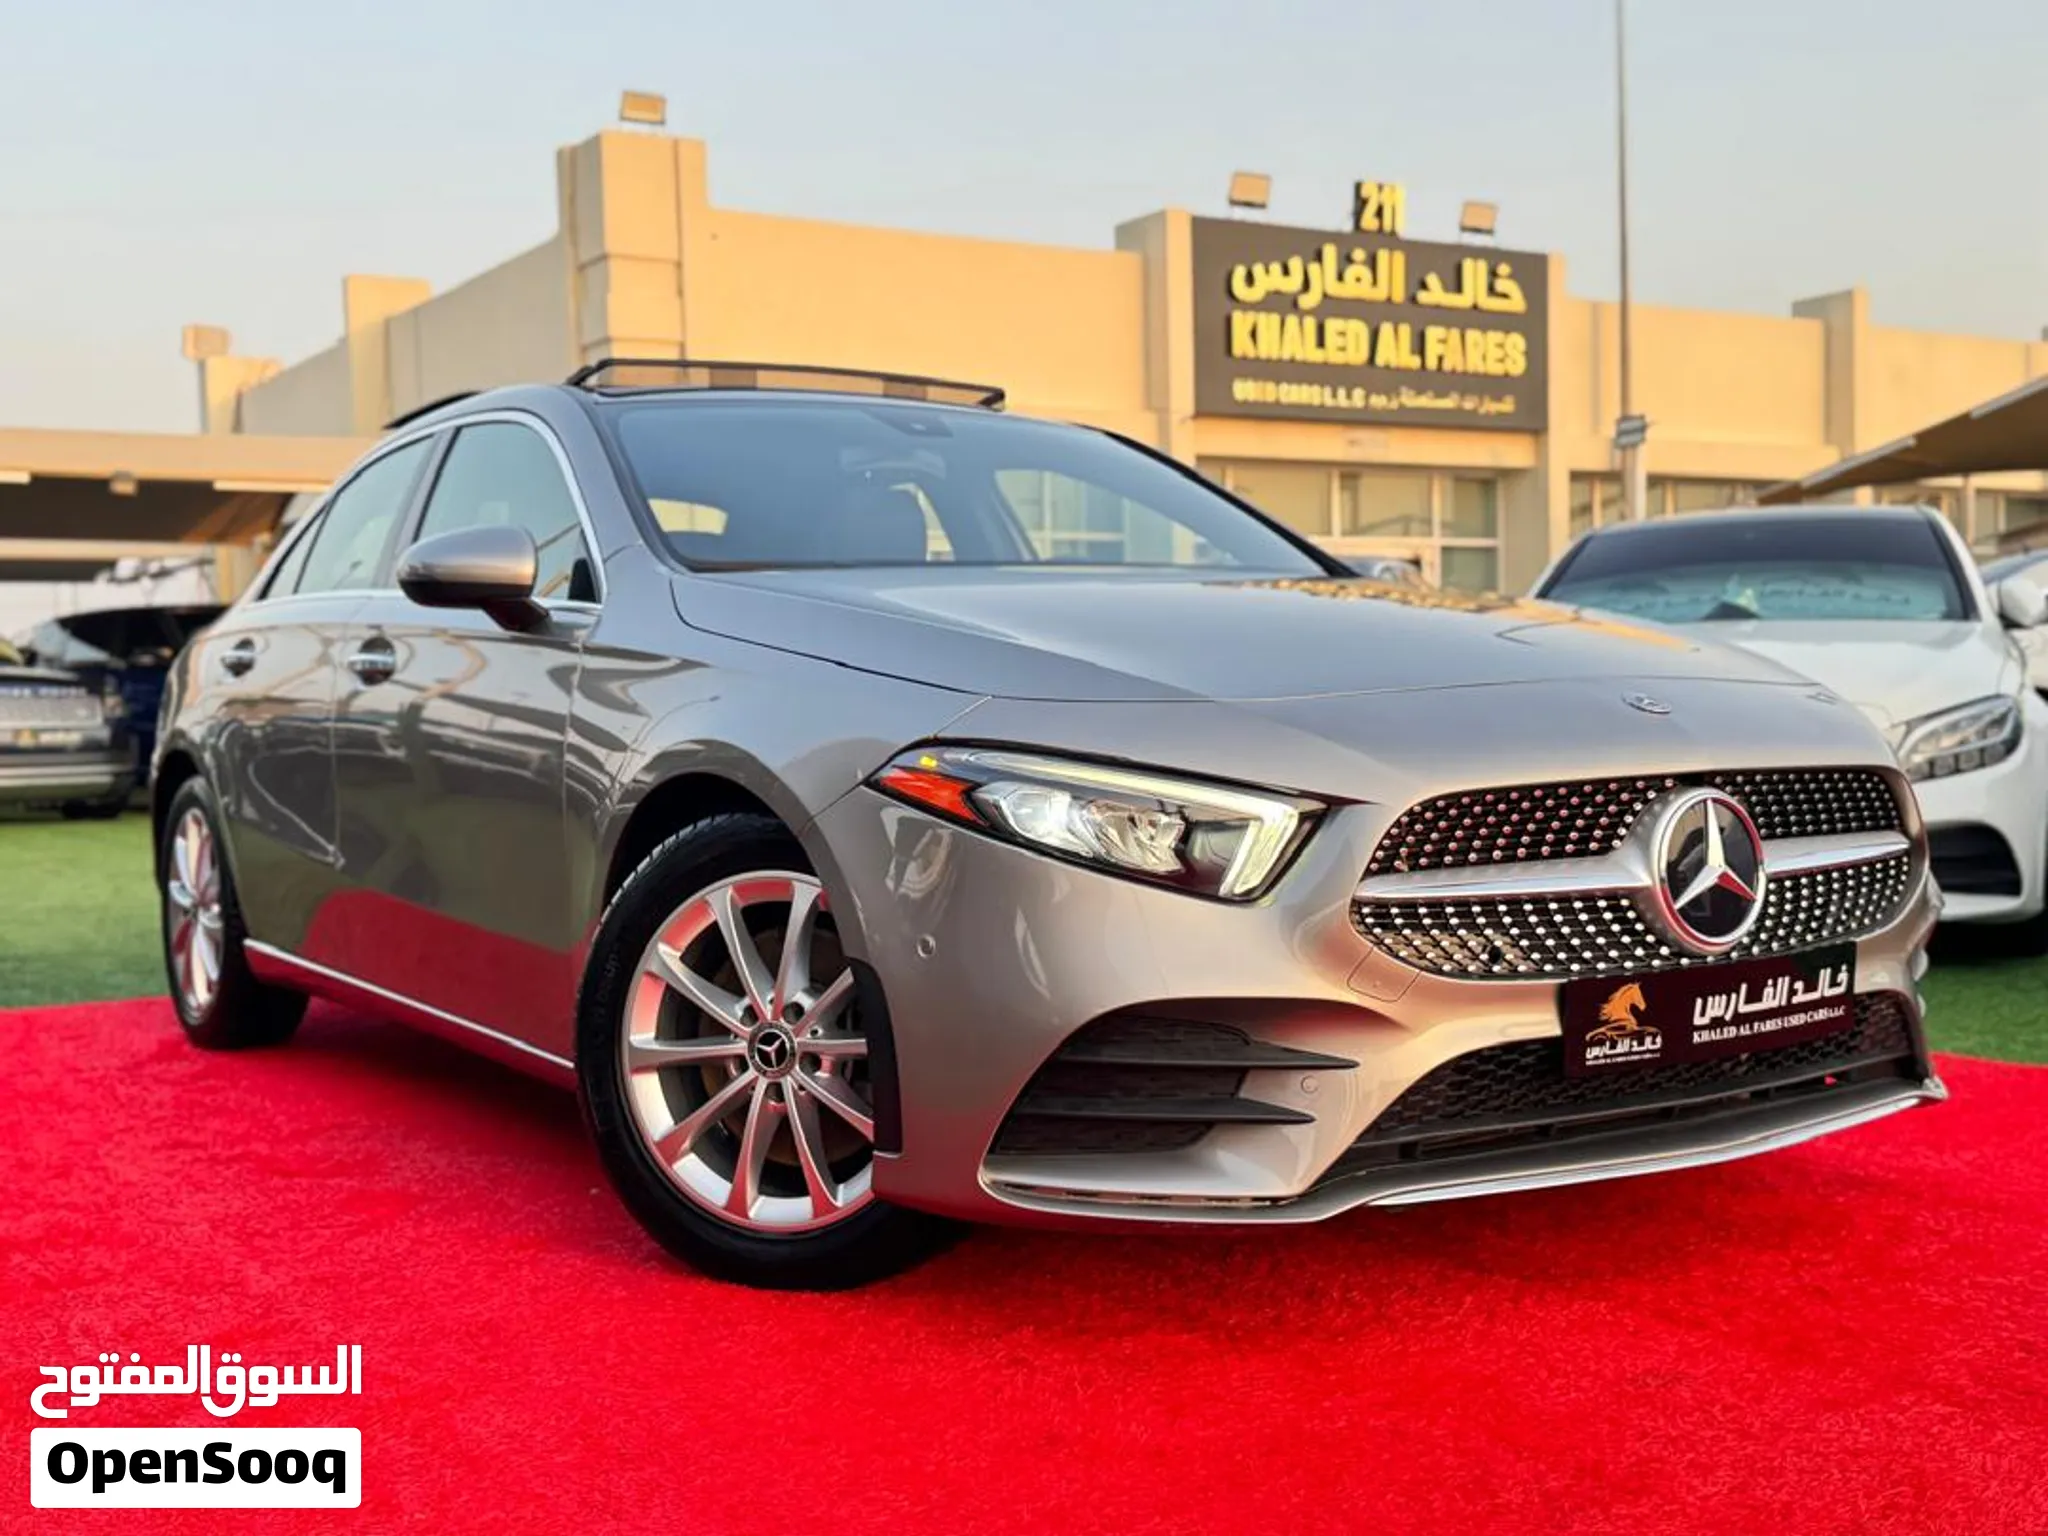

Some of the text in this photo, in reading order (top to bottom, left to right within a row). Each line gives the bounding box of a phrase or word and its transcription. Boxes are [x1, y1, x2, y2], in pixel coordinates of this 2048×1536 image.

[1357, 181, 1405, 234] 211
[1231, 243, 1527, 314] خالد الفارس
[1230, 309, 1527, 377] KHALED AL FARES
[1693, 964, 1849, 1026] خالد الفارس
[1692, 1025, 1738, 1044] KHALED
[1738, 1022, 1752, 1036] AL
[1753, 1016, 1782, 1033] FARES
[1783, 1012, 1807, 1028] USED
